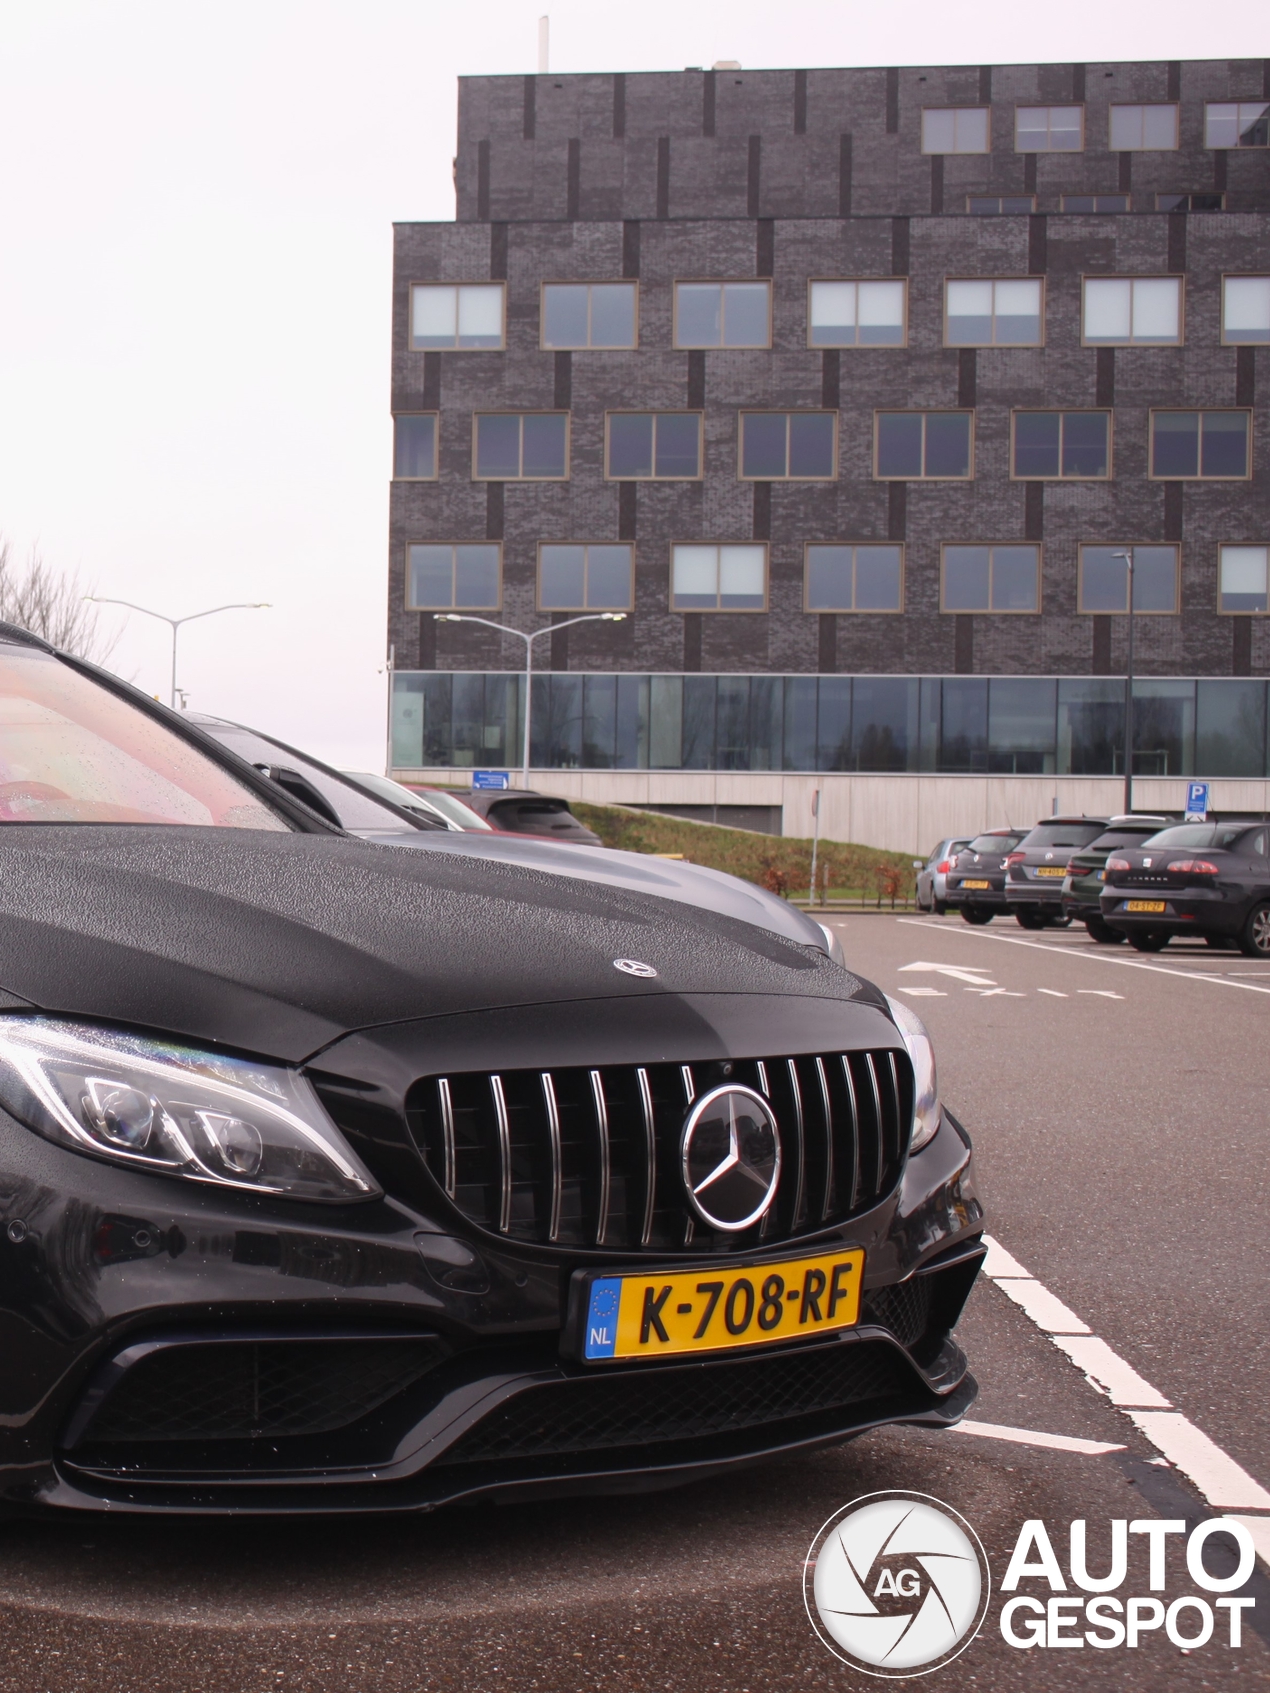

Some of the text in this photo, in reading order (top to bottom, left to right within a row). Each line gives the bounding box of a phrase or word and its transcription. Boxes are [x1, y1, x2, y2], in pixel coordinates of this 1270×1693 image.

[1191, 785, 1204, 800] P
[639, 1262, 853, 1344] K-708-RF
[590, 1327, 611, 1345] NL
